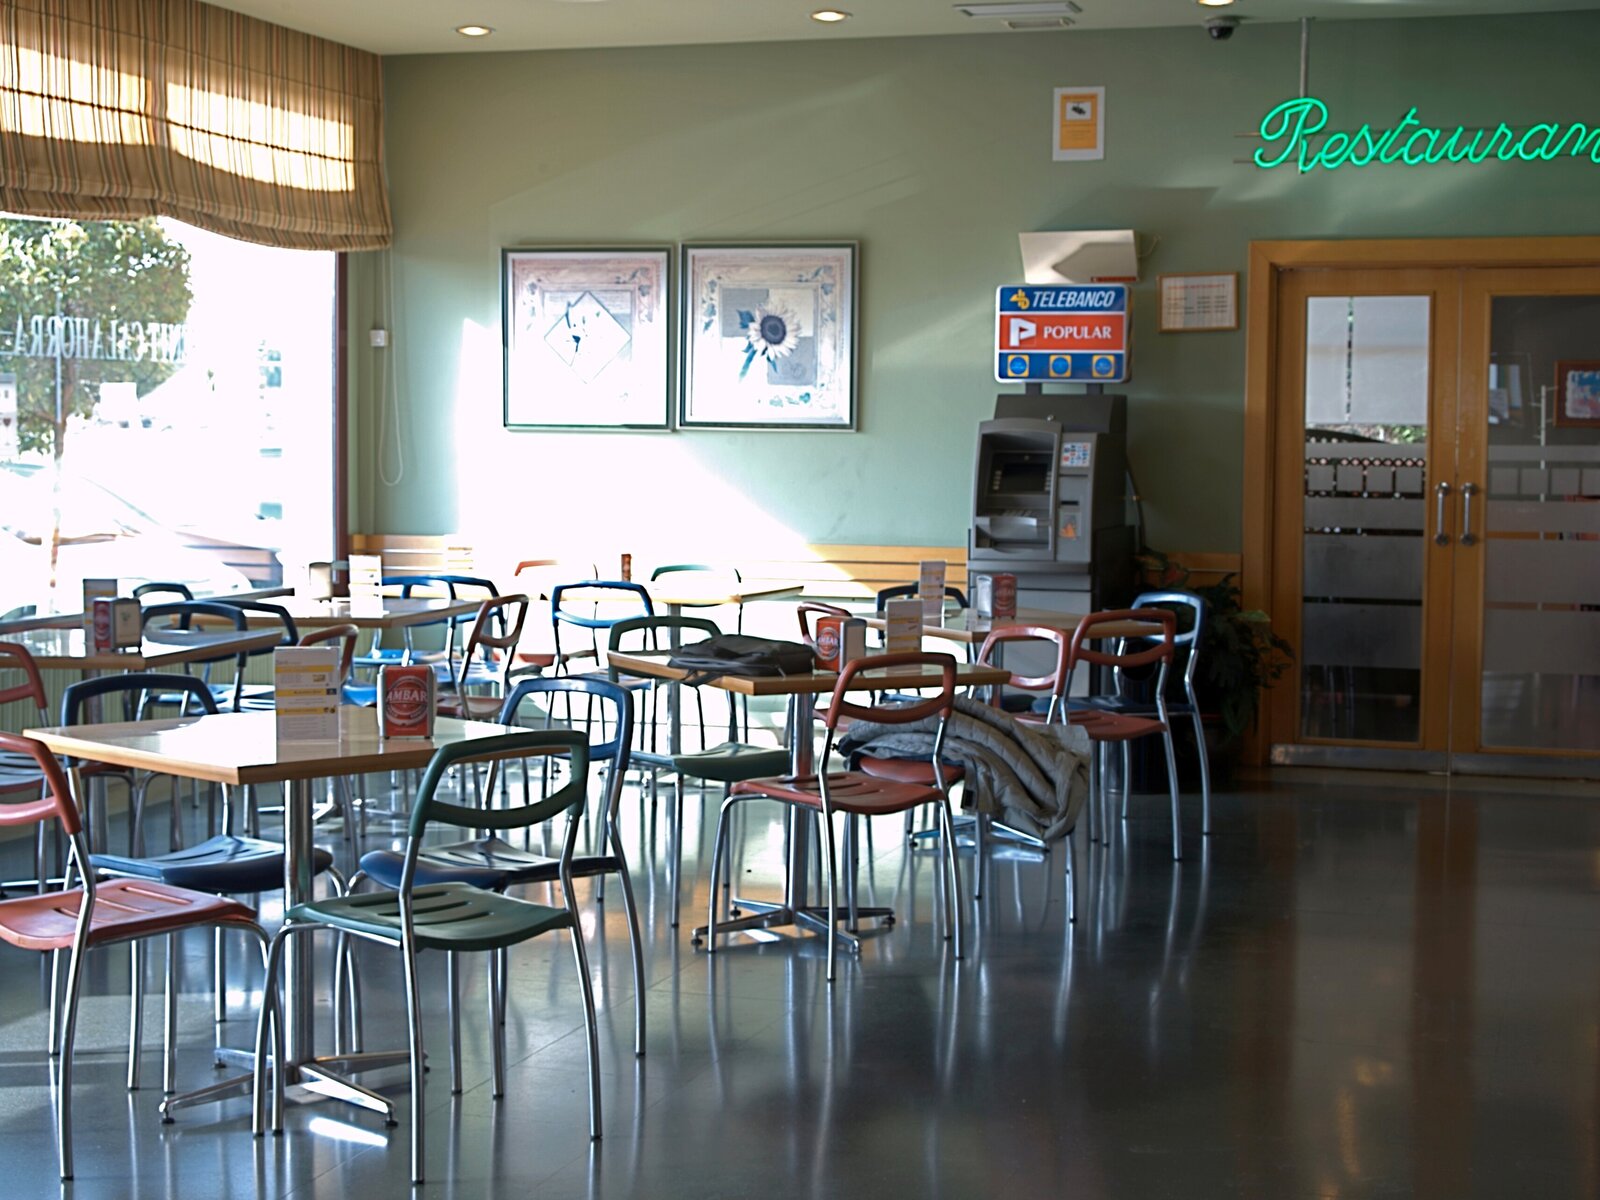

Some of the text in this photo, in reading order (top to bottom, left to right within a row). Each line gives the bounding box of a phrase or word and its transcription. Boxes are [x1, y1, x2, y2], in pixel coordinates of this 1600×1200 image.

[1032, 291, 1116, 308] TELEBANCO
[1043, 326, 1112, 339] POPULAR
[386, 689, 427, 702] AMBAR
